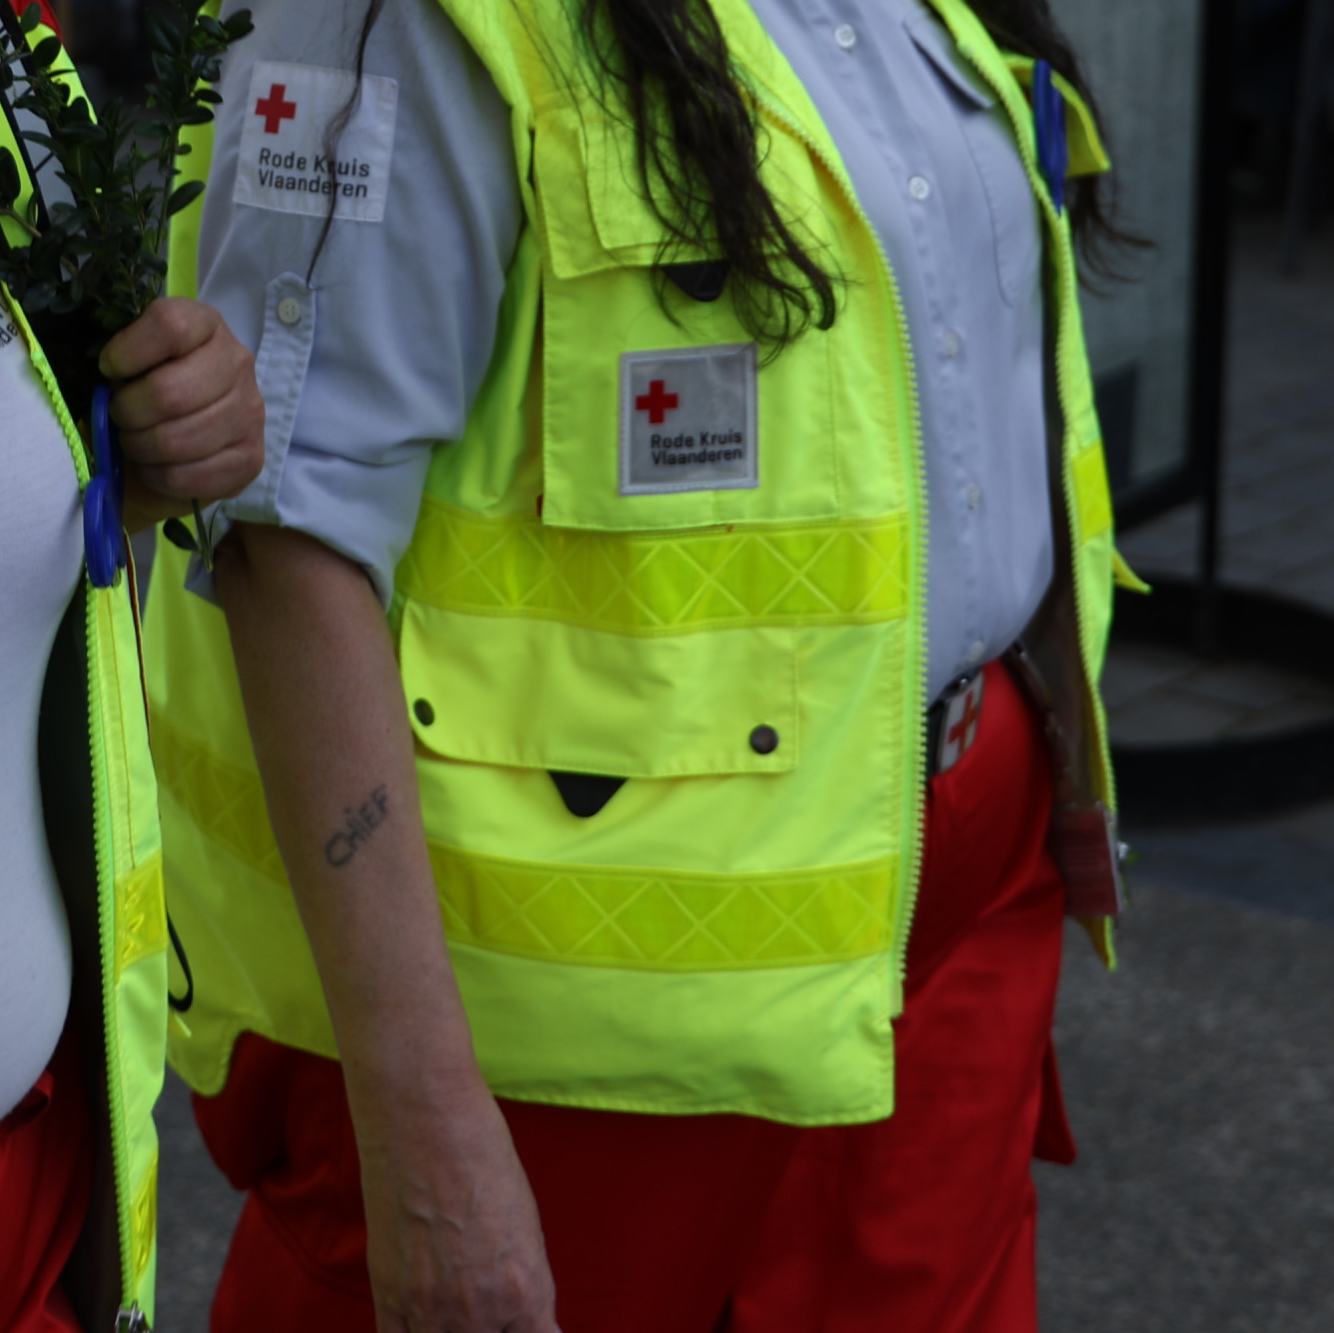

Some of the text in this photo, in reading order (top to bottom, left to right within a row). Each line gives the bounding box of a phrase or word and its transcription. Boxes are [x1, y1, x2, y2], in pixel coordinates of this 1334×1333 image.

[259, 148, 370, 178] Rode Kruis
[259, 168, 368, 198] Vlaanderen
[651, 429, 742, 448] Rode Kruis
[652, 448, 742, 465] Vlaanderen
